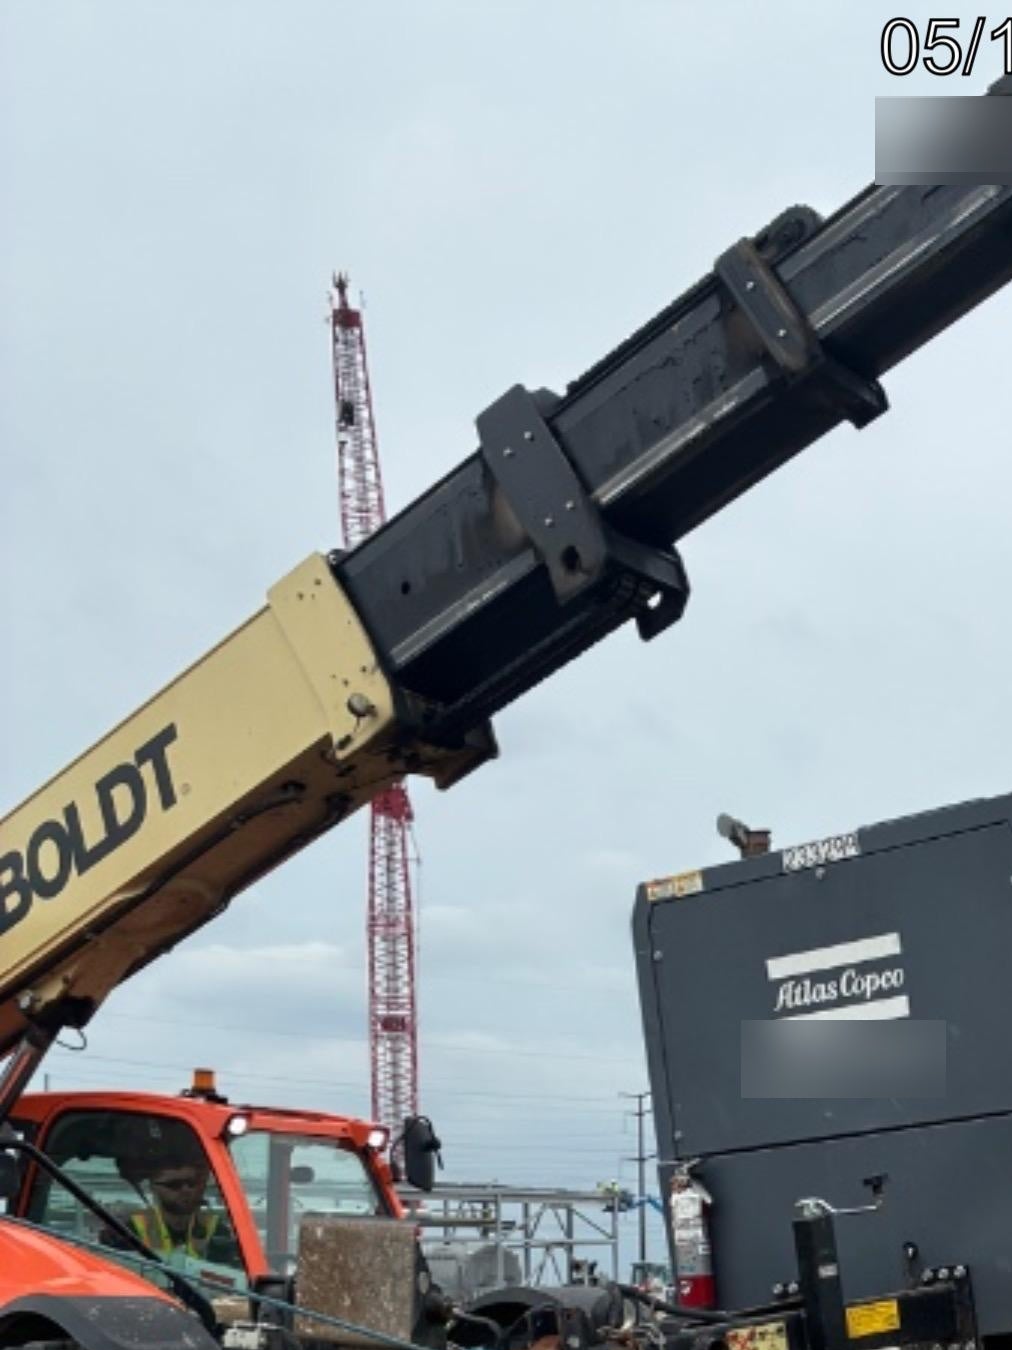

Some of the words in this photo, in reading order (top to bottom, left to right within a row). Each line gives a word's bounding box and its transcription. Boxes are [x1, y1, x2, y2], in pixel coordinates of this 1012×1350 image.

[0, 722, 178, 936] BOLDT
[773, 978, 838, 1012] Atlas
[839, 968, 905, 999] Copco
